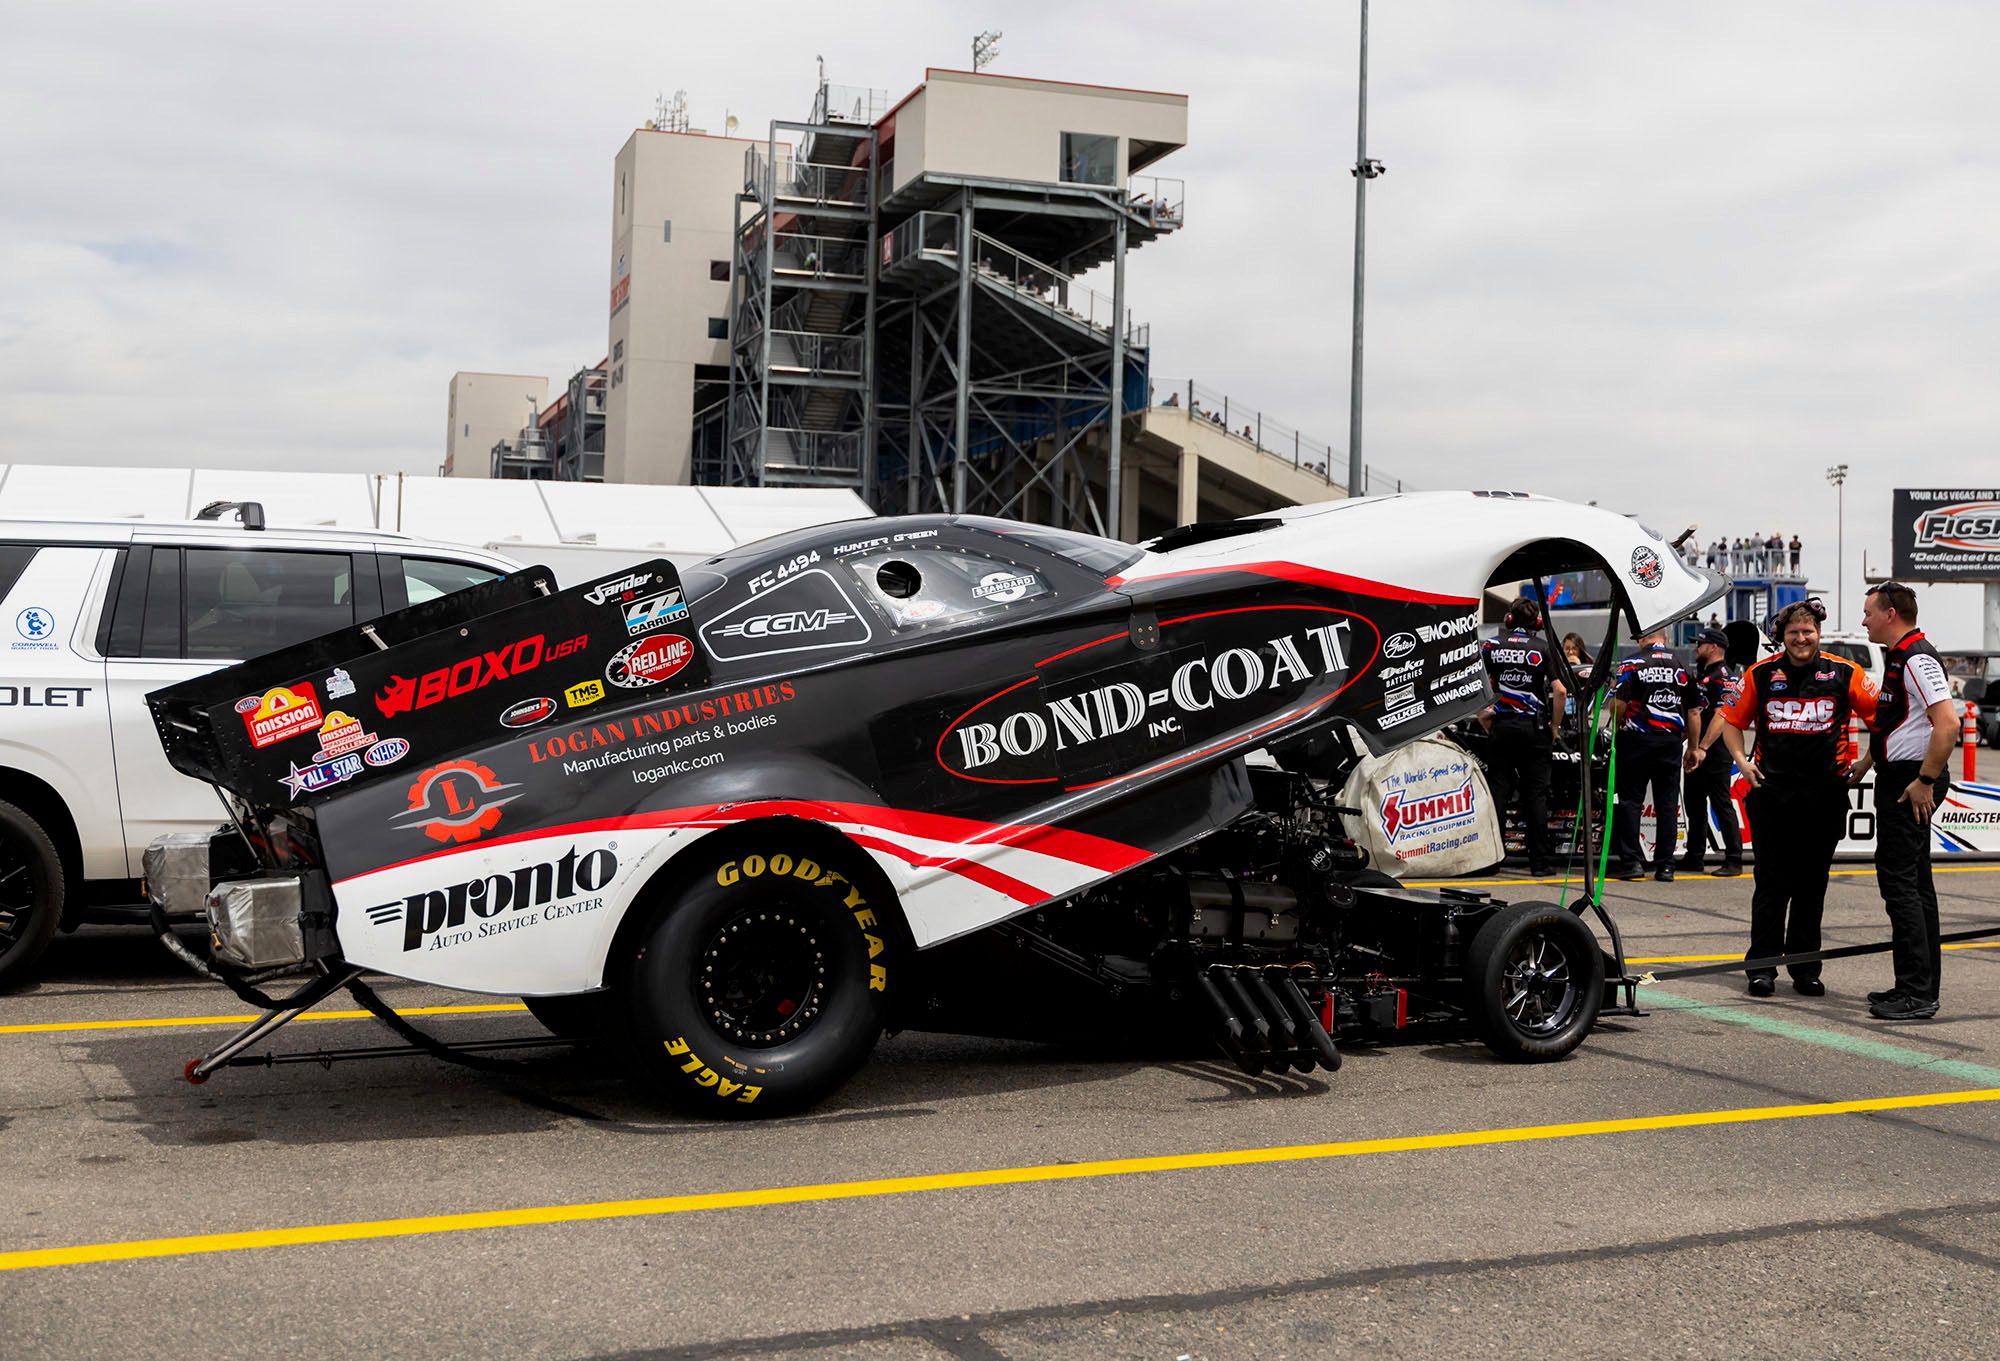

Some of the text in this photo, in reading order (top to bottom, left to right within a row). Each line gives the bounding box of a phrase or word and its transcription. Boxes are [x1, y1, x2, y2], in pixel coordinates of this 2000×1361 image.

[1910, 491, 1931, 500] YOUR
[1933, 491, 1949, 500] LAS
[1949, 491, 1975, 500] VEGAS
[1976, 491, 1994, 500] AND
[833, 530, 938, 554] HUNTER GREEN
[748, 550, 820, 595] FC 4494
[584, 573, 652, 605] Sander
[975, 577, 1031, 597] STANDARD
[630, 610, 687, 634] CARRILLO
[743, 609, 829, 638] CGM
[632, 640, 688, 673] RED LINE
[1385, 635, 1413, 658] Gates
[1440, 640, 1479, 666] MOOG
[1491, 649, 1525, 657] MATCO
[416, 634, 544, 710] BOXO
[545, 634, 588, 662] USA
[1378, 659, 1424, 680] Deka
[1386, 668, 1423, 688] BATTERIES
[1522, 675, 1533, 683] OIL
[1638, 667, 1674, 678] MATCO
[1640, 674, 1674, 683] TOOLS
[570, 684, 598, 700] TMS
[957, 618, 1351, 770] BOND-COAT
[1442, 679, 1483, 703] WAGNER
[1648, 694, 1669, 703] LUCAS
[255, 706, 315, 735] MISSION
[528, 681, 796, 763] LOGAN INDUSTRIES
[1377, 702, 1426, 728] WALKER
[1767, 700, 1834, 722] SCAG
[321, 723, 359, 742] MISSION
[1149, 717, 1182, 738] INC.
[329, 735, 375, 755] CHALLENGE
[372, 742, 403, 761] NHRA
[563, 714, 777, 775] Manufacturing parts & bodies
[307, 767, 328, 787] ALL
[332, 756, 361, 777] STAR
[633, 751, 725, 783] logankc.com
[1381, 775, 1400, 791] The
[1429, 765, 1449, 782] Speed
[1450, 763, 1468, 775] Shop
[439, 778, 475, 816] L
[1383, 783, 1472, 836] SUMMIT
[1400, 818, 1475, 840] RACING EQUIPMENT
[1311, 850, 1326, 867] MSD
[1396, 832, 1478, 860] SummitRacing.com
[403, 844, 617, 952] pronto
[430, 897, 603, 951] AUTO SERVICE CENTER
[717, 854, 887, 992] GOODYEAR
[664, 1037, 763, 1103] EAGLE
